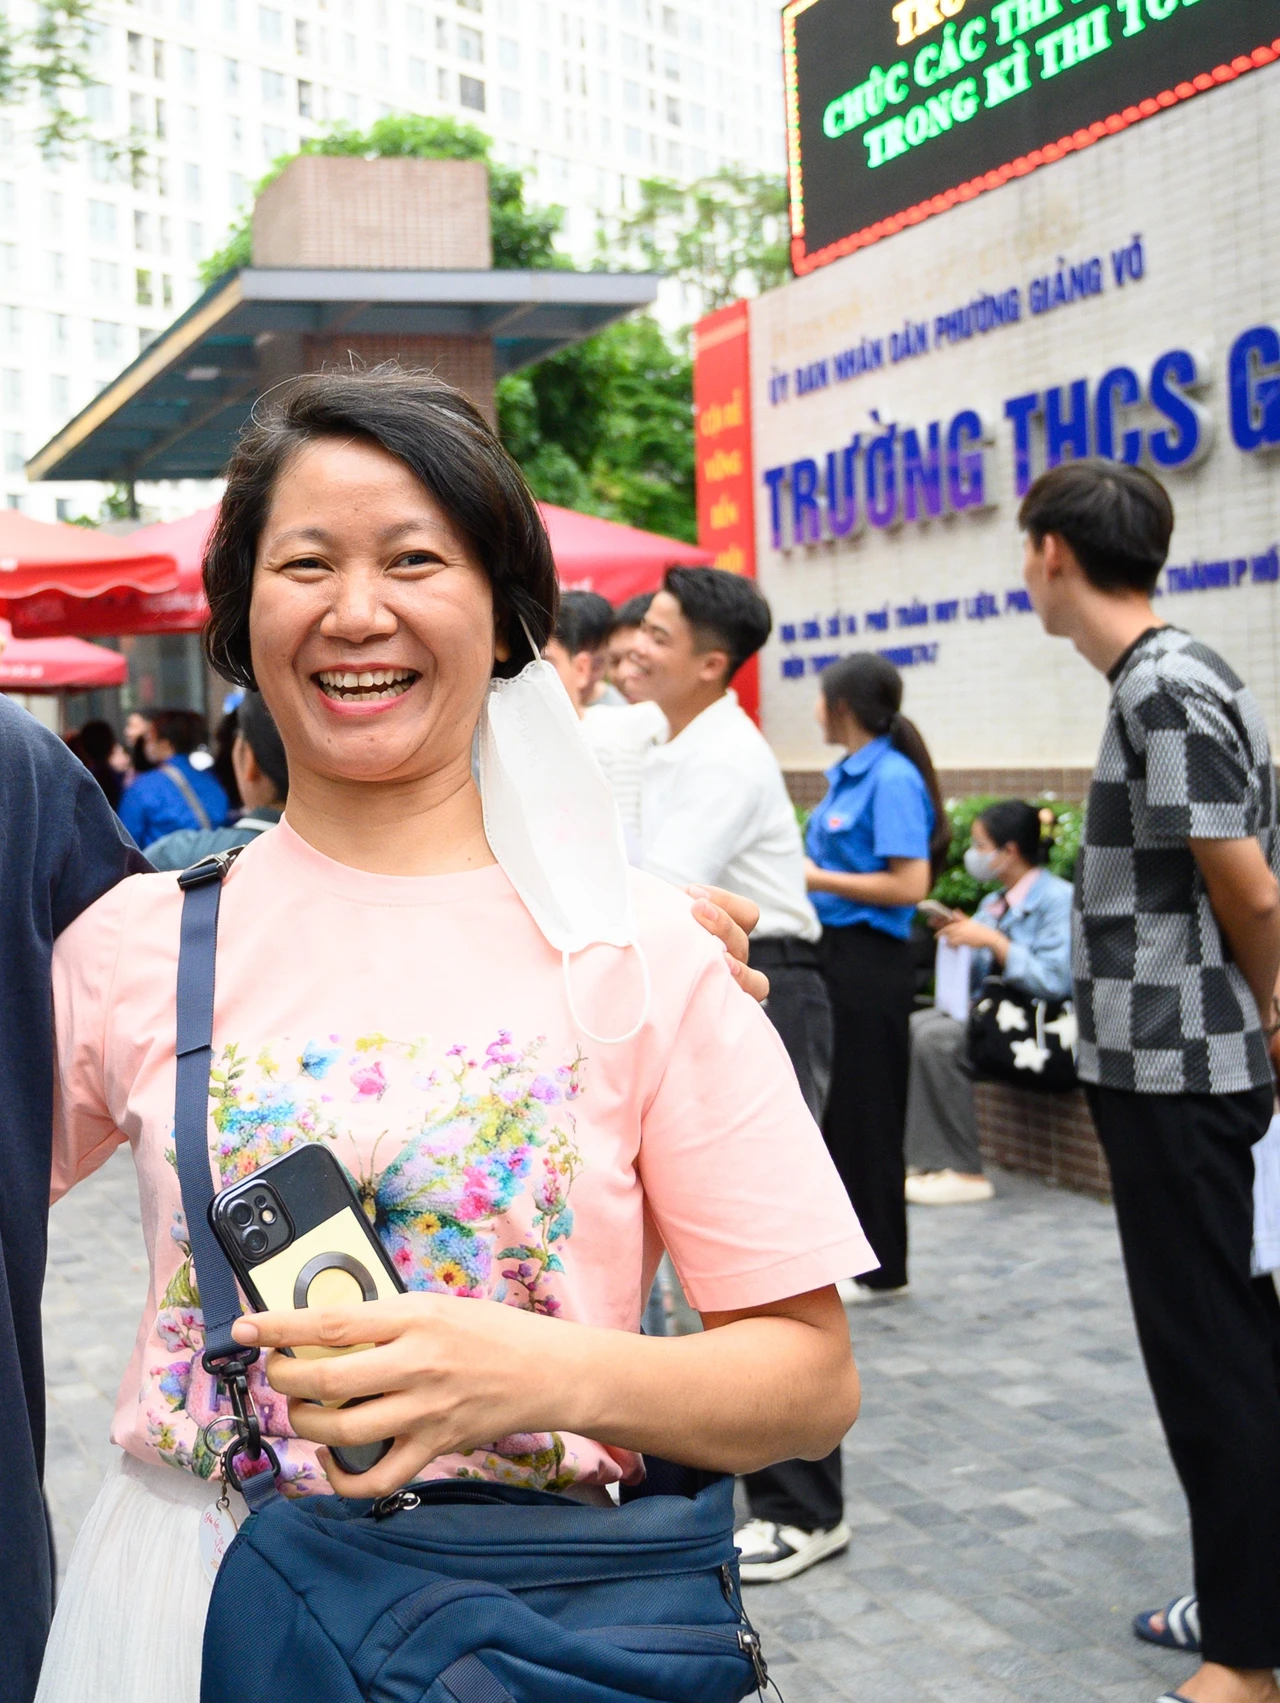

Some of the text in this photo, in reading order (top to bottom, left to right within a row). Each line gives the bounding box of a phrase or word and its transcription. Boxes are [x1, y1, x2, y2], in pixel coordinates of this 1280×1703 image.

[863, 77, 979, 168] TRONG
[983, 39, 1032, 108] KÌ
[1035, 5, 1112, 79] THI
[914, 16, 986, 87] CÁC
[935, 288, 1019, 347] PHƯỜNG
[1030, 256, 1102, 315] GIẢNG
[764, 409, 984, 550] TRƯỜNG
[1004, 348, 1199, 498] THCS
